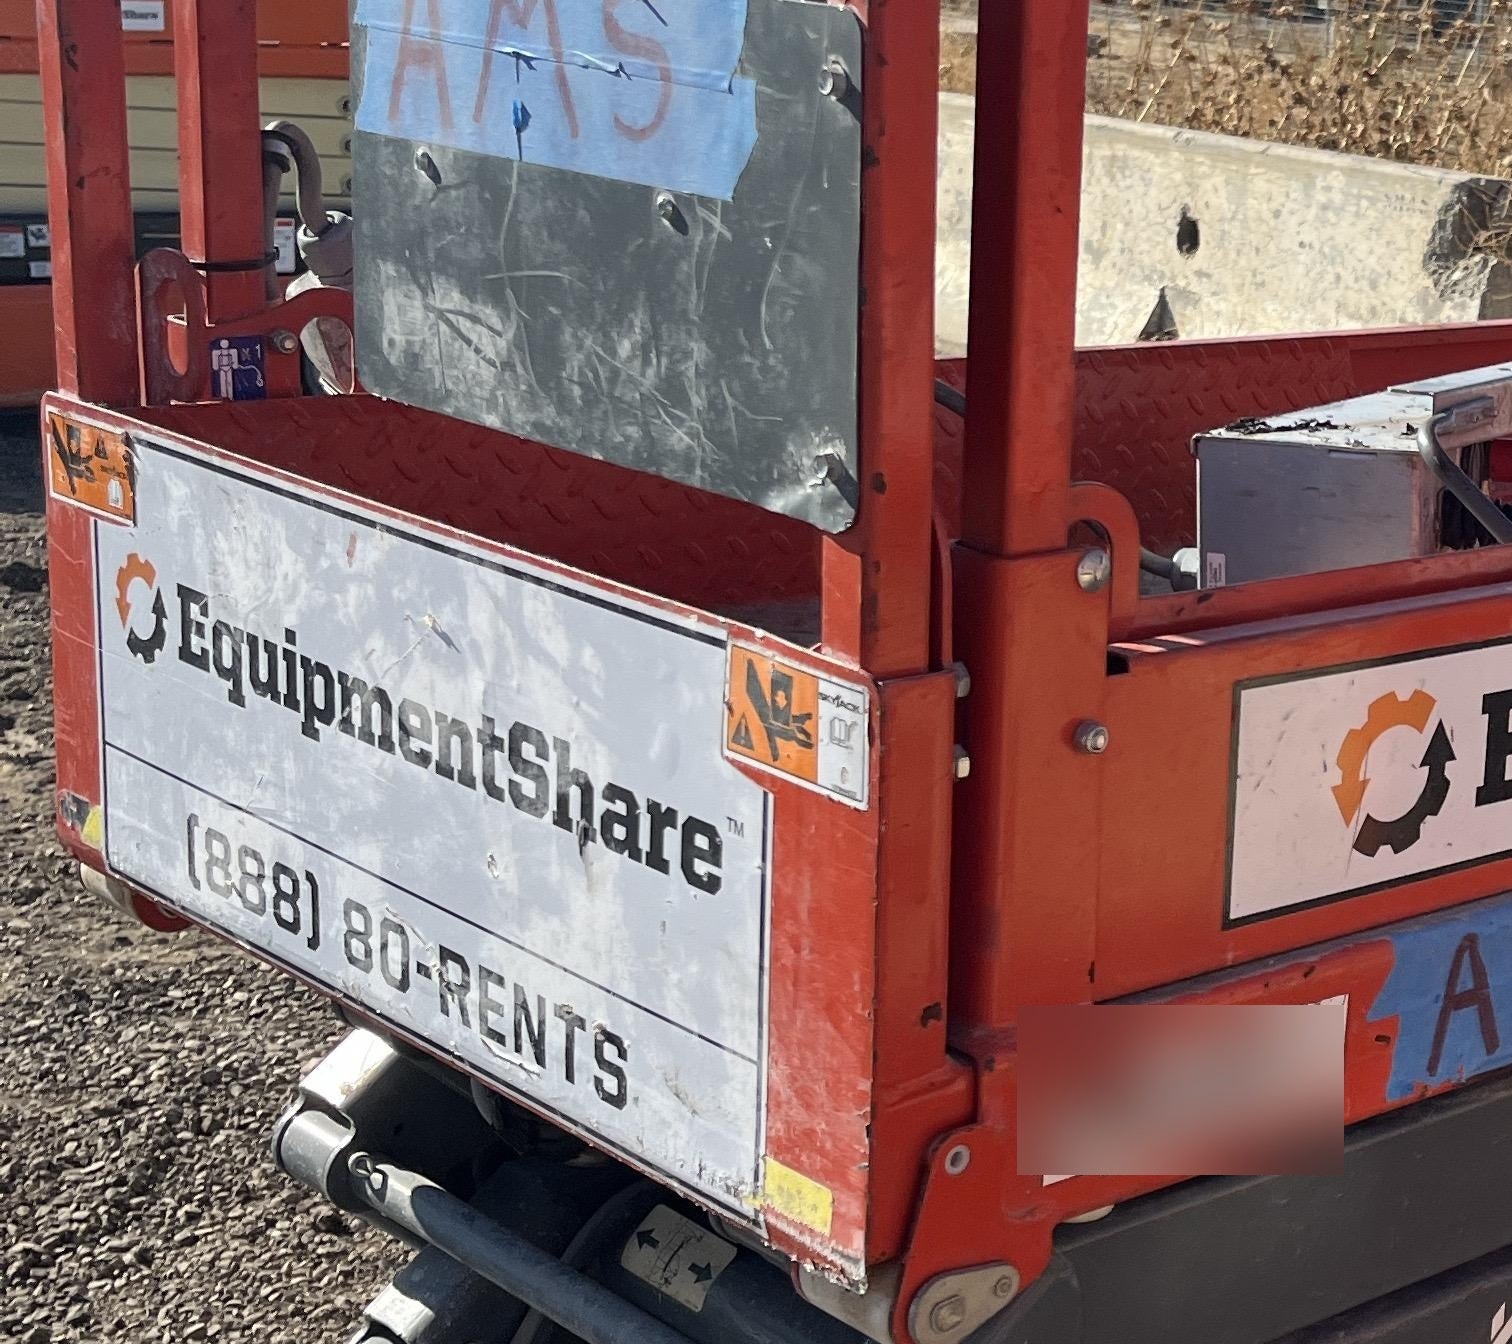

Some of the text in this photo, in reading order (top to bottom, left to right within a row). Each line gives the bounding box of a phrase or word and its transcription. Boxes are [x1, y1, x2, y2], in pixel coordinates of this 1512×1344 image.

[176, 582, 723, 896] EquipmentShare
[186, 812, 628, 1111] (888) 80-RENTS
